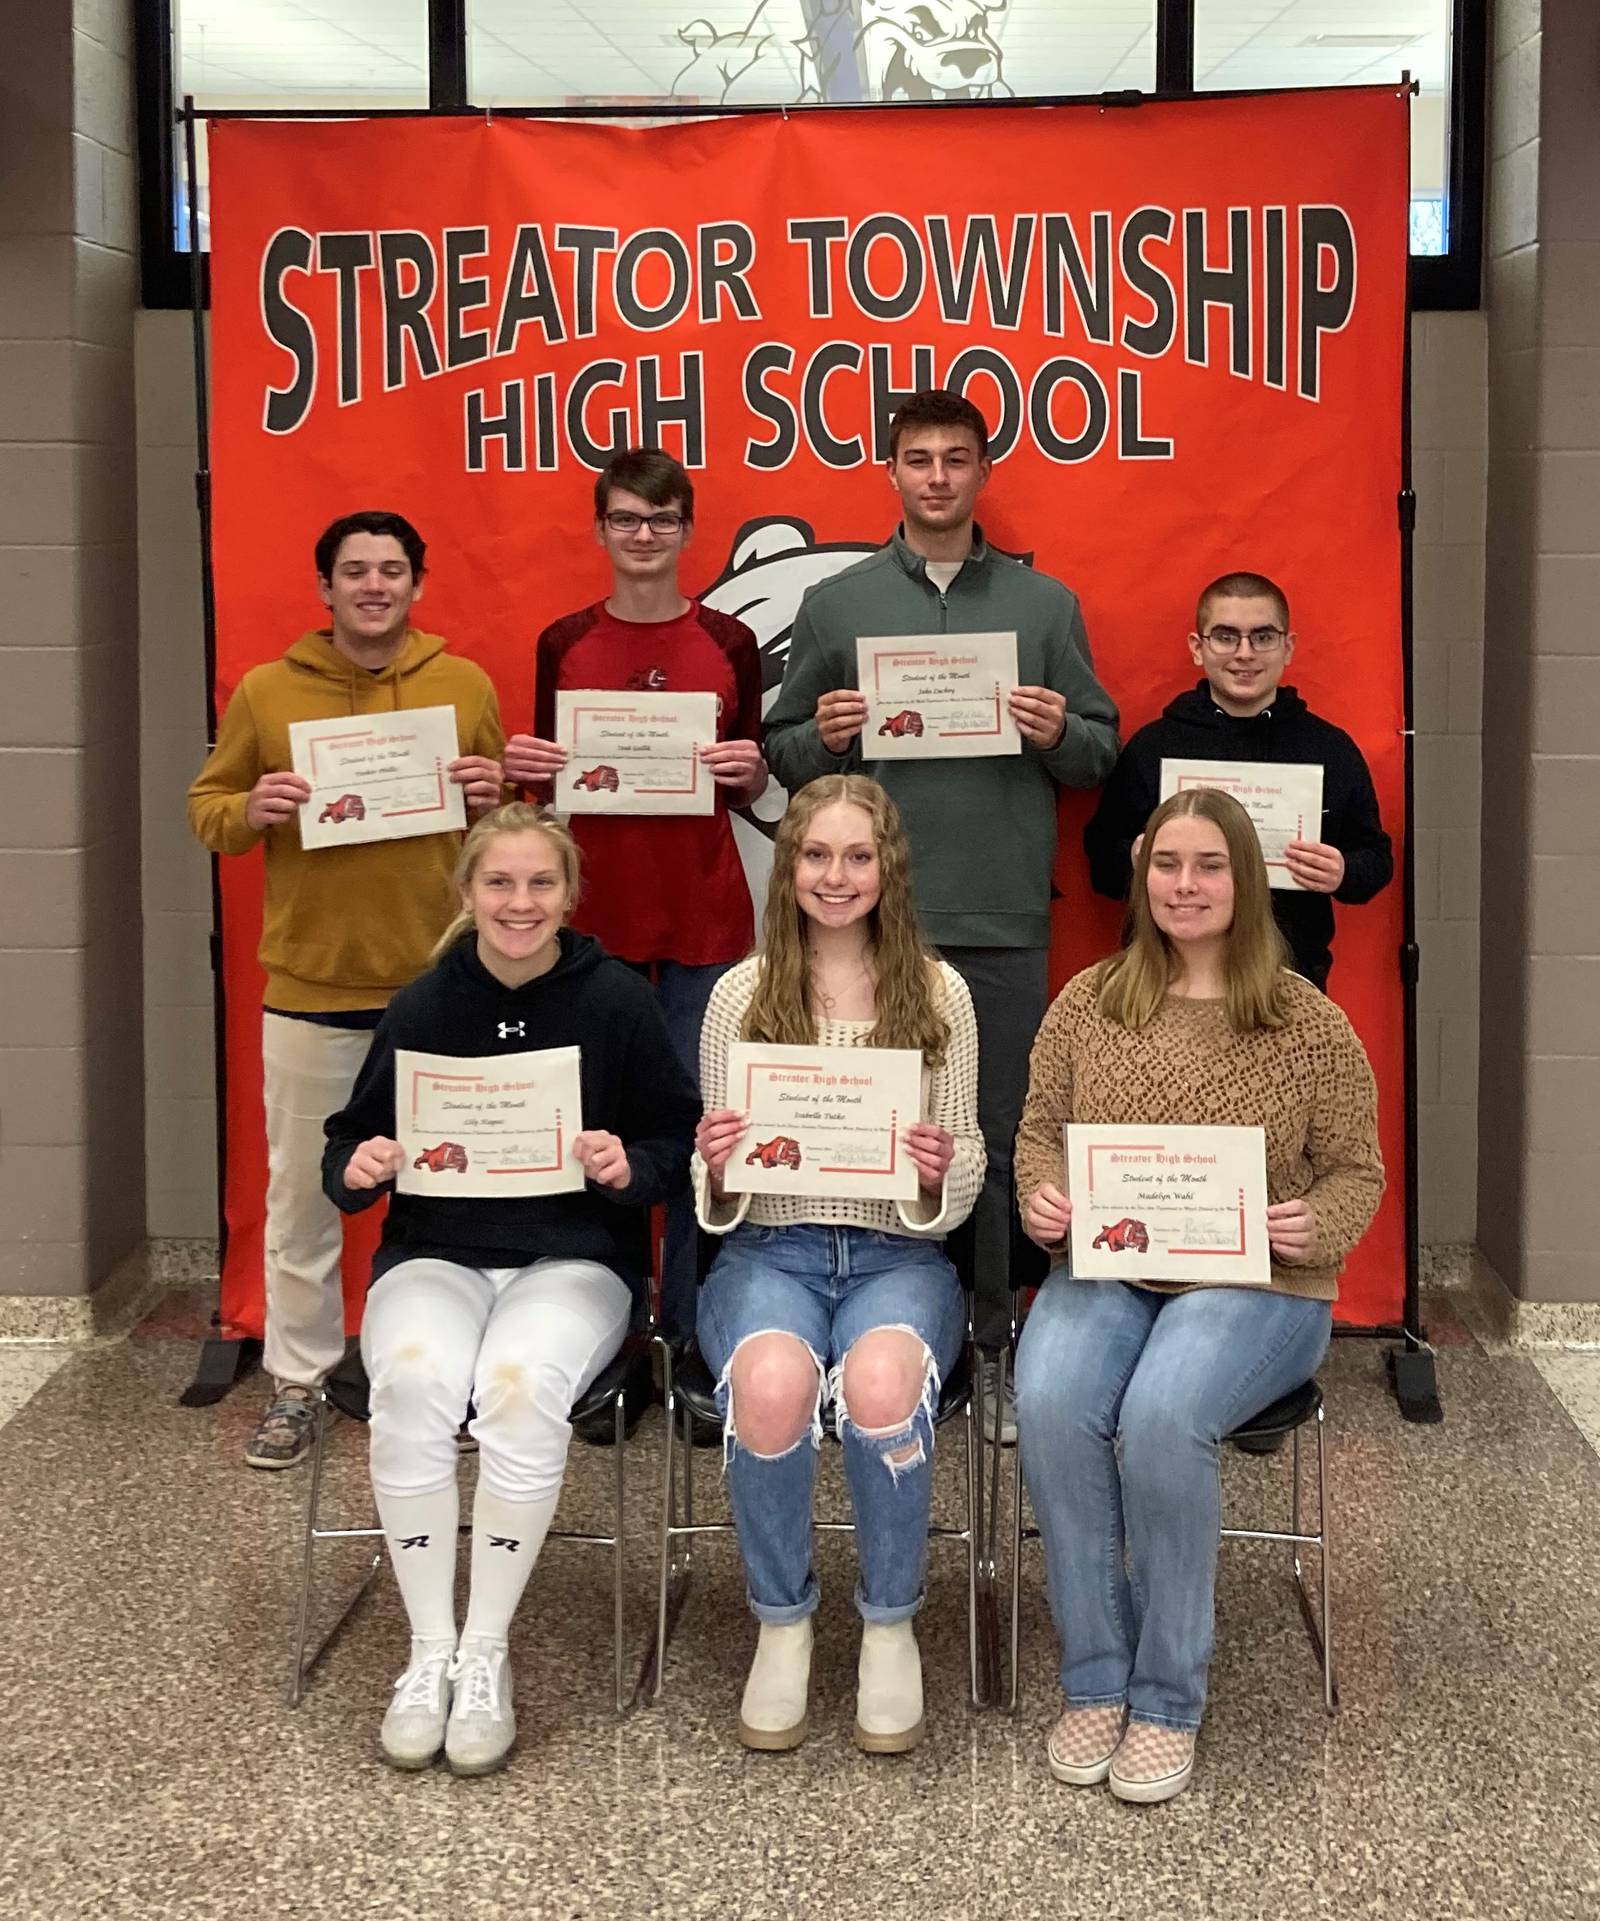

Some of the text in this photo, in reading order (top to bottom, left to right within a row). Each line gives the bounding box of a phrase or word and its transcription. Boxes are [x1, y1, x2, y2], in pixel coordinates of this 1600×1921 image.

[260, 204, 1357, 436] STREATOR TOWNSHIP
[464, 340, 1175, 473] HIGH SCHOOL
[839, 1075, 873, 1086] School
[778, 1093, 862, 1104] Student of the Month
[1156, 1153, 1180, 1165] High
[1183, 1154, 1217, 1164] School
[1122, 1173, 1207, 1184] Student of the Month
